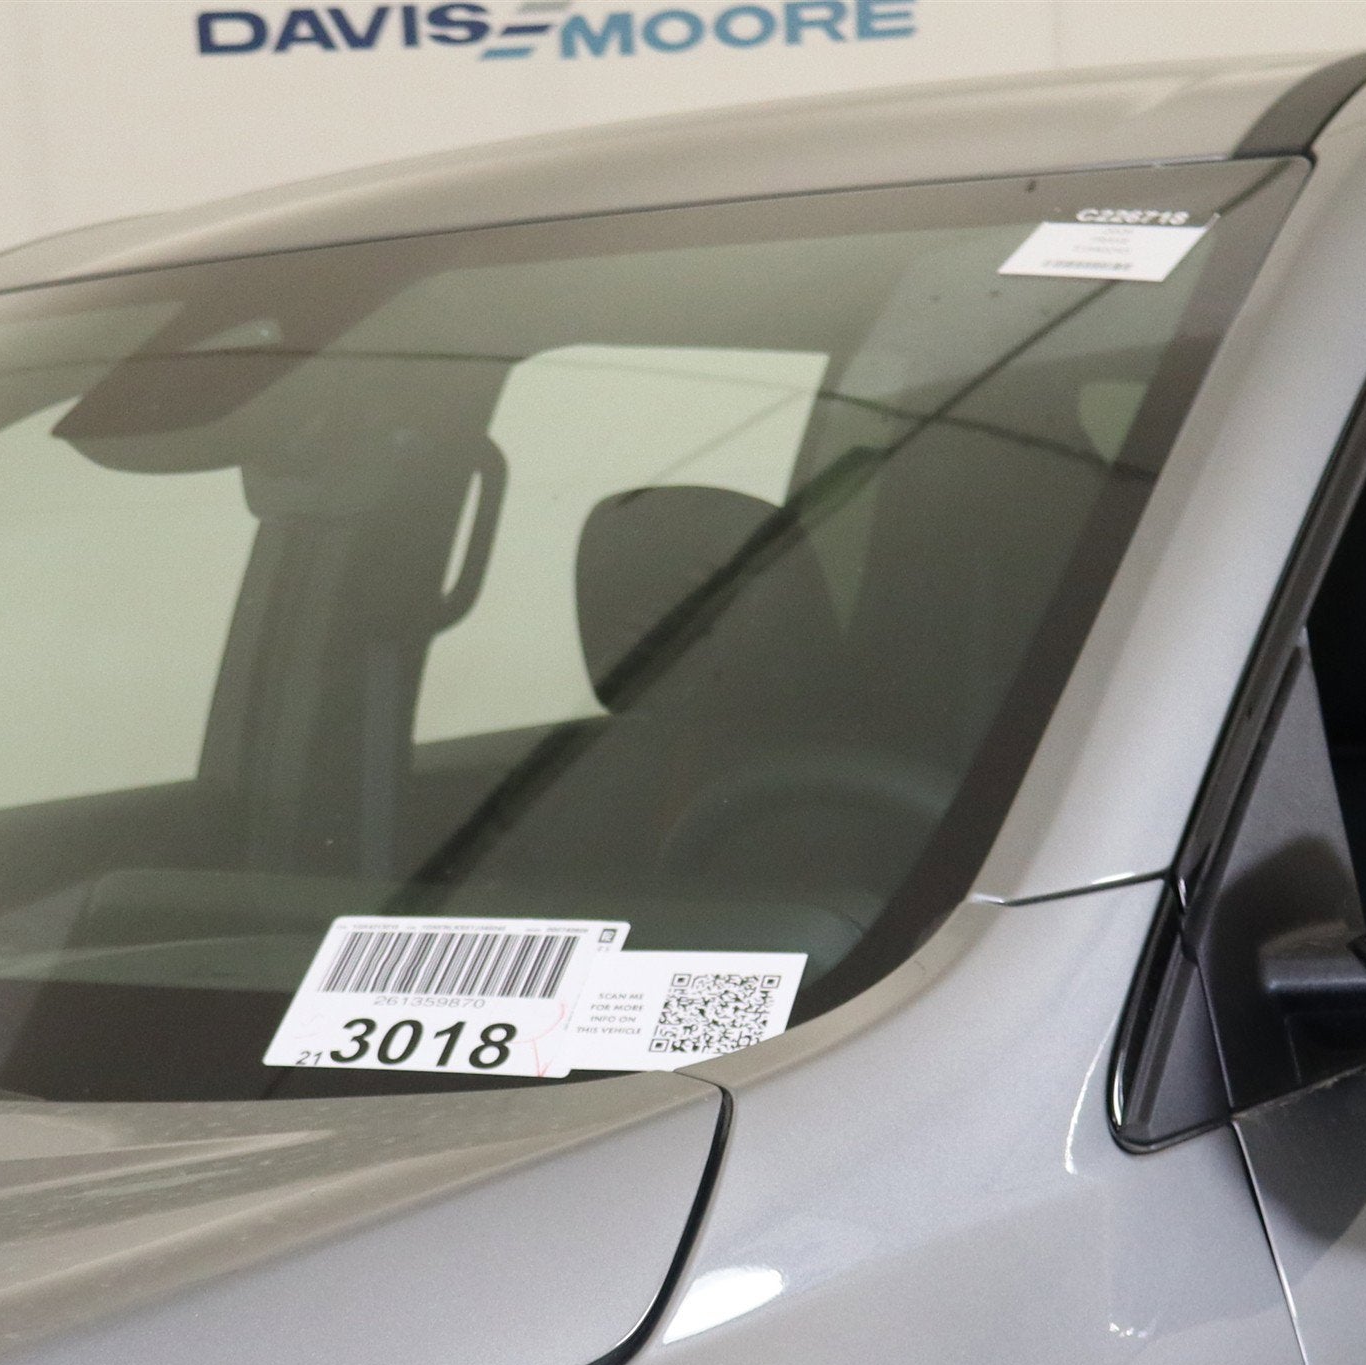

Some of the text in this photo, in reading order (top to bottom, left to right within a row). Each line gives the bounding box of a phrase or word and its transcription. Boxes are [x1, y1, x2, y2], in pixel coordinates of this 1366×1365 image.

[197, 0, 919, 60] DAVIS MOORE
[373, 995, 486, 1009] 261359870
[295, 1017, 518, 1069] 21 3018
[577, 1026, 641, 1035] THIS VEHICLE
